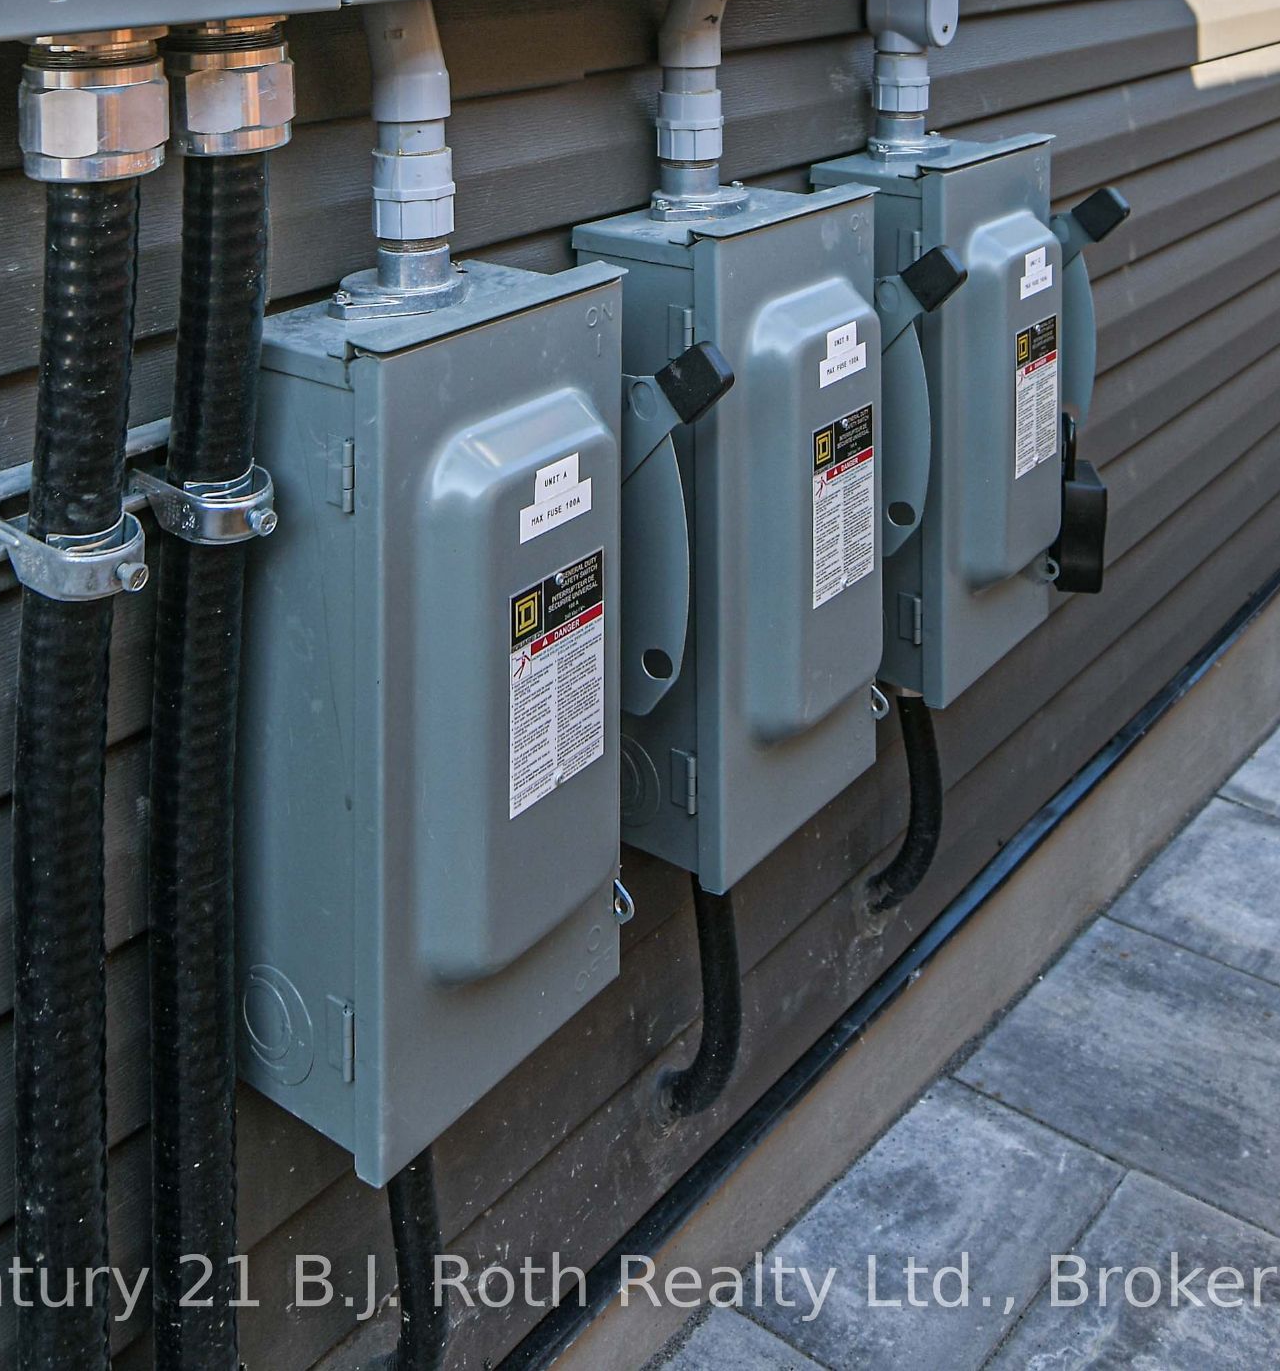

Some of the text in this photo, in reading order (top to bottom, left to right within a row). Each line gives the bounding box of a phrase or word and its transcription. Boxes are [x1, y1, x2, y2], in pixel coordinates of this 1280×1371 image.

[544, 471, 568, 488] UNIT A
[531, 496, 581, 527] MAX FUSE 100A
[554, 618, 580, 640] DANGER
